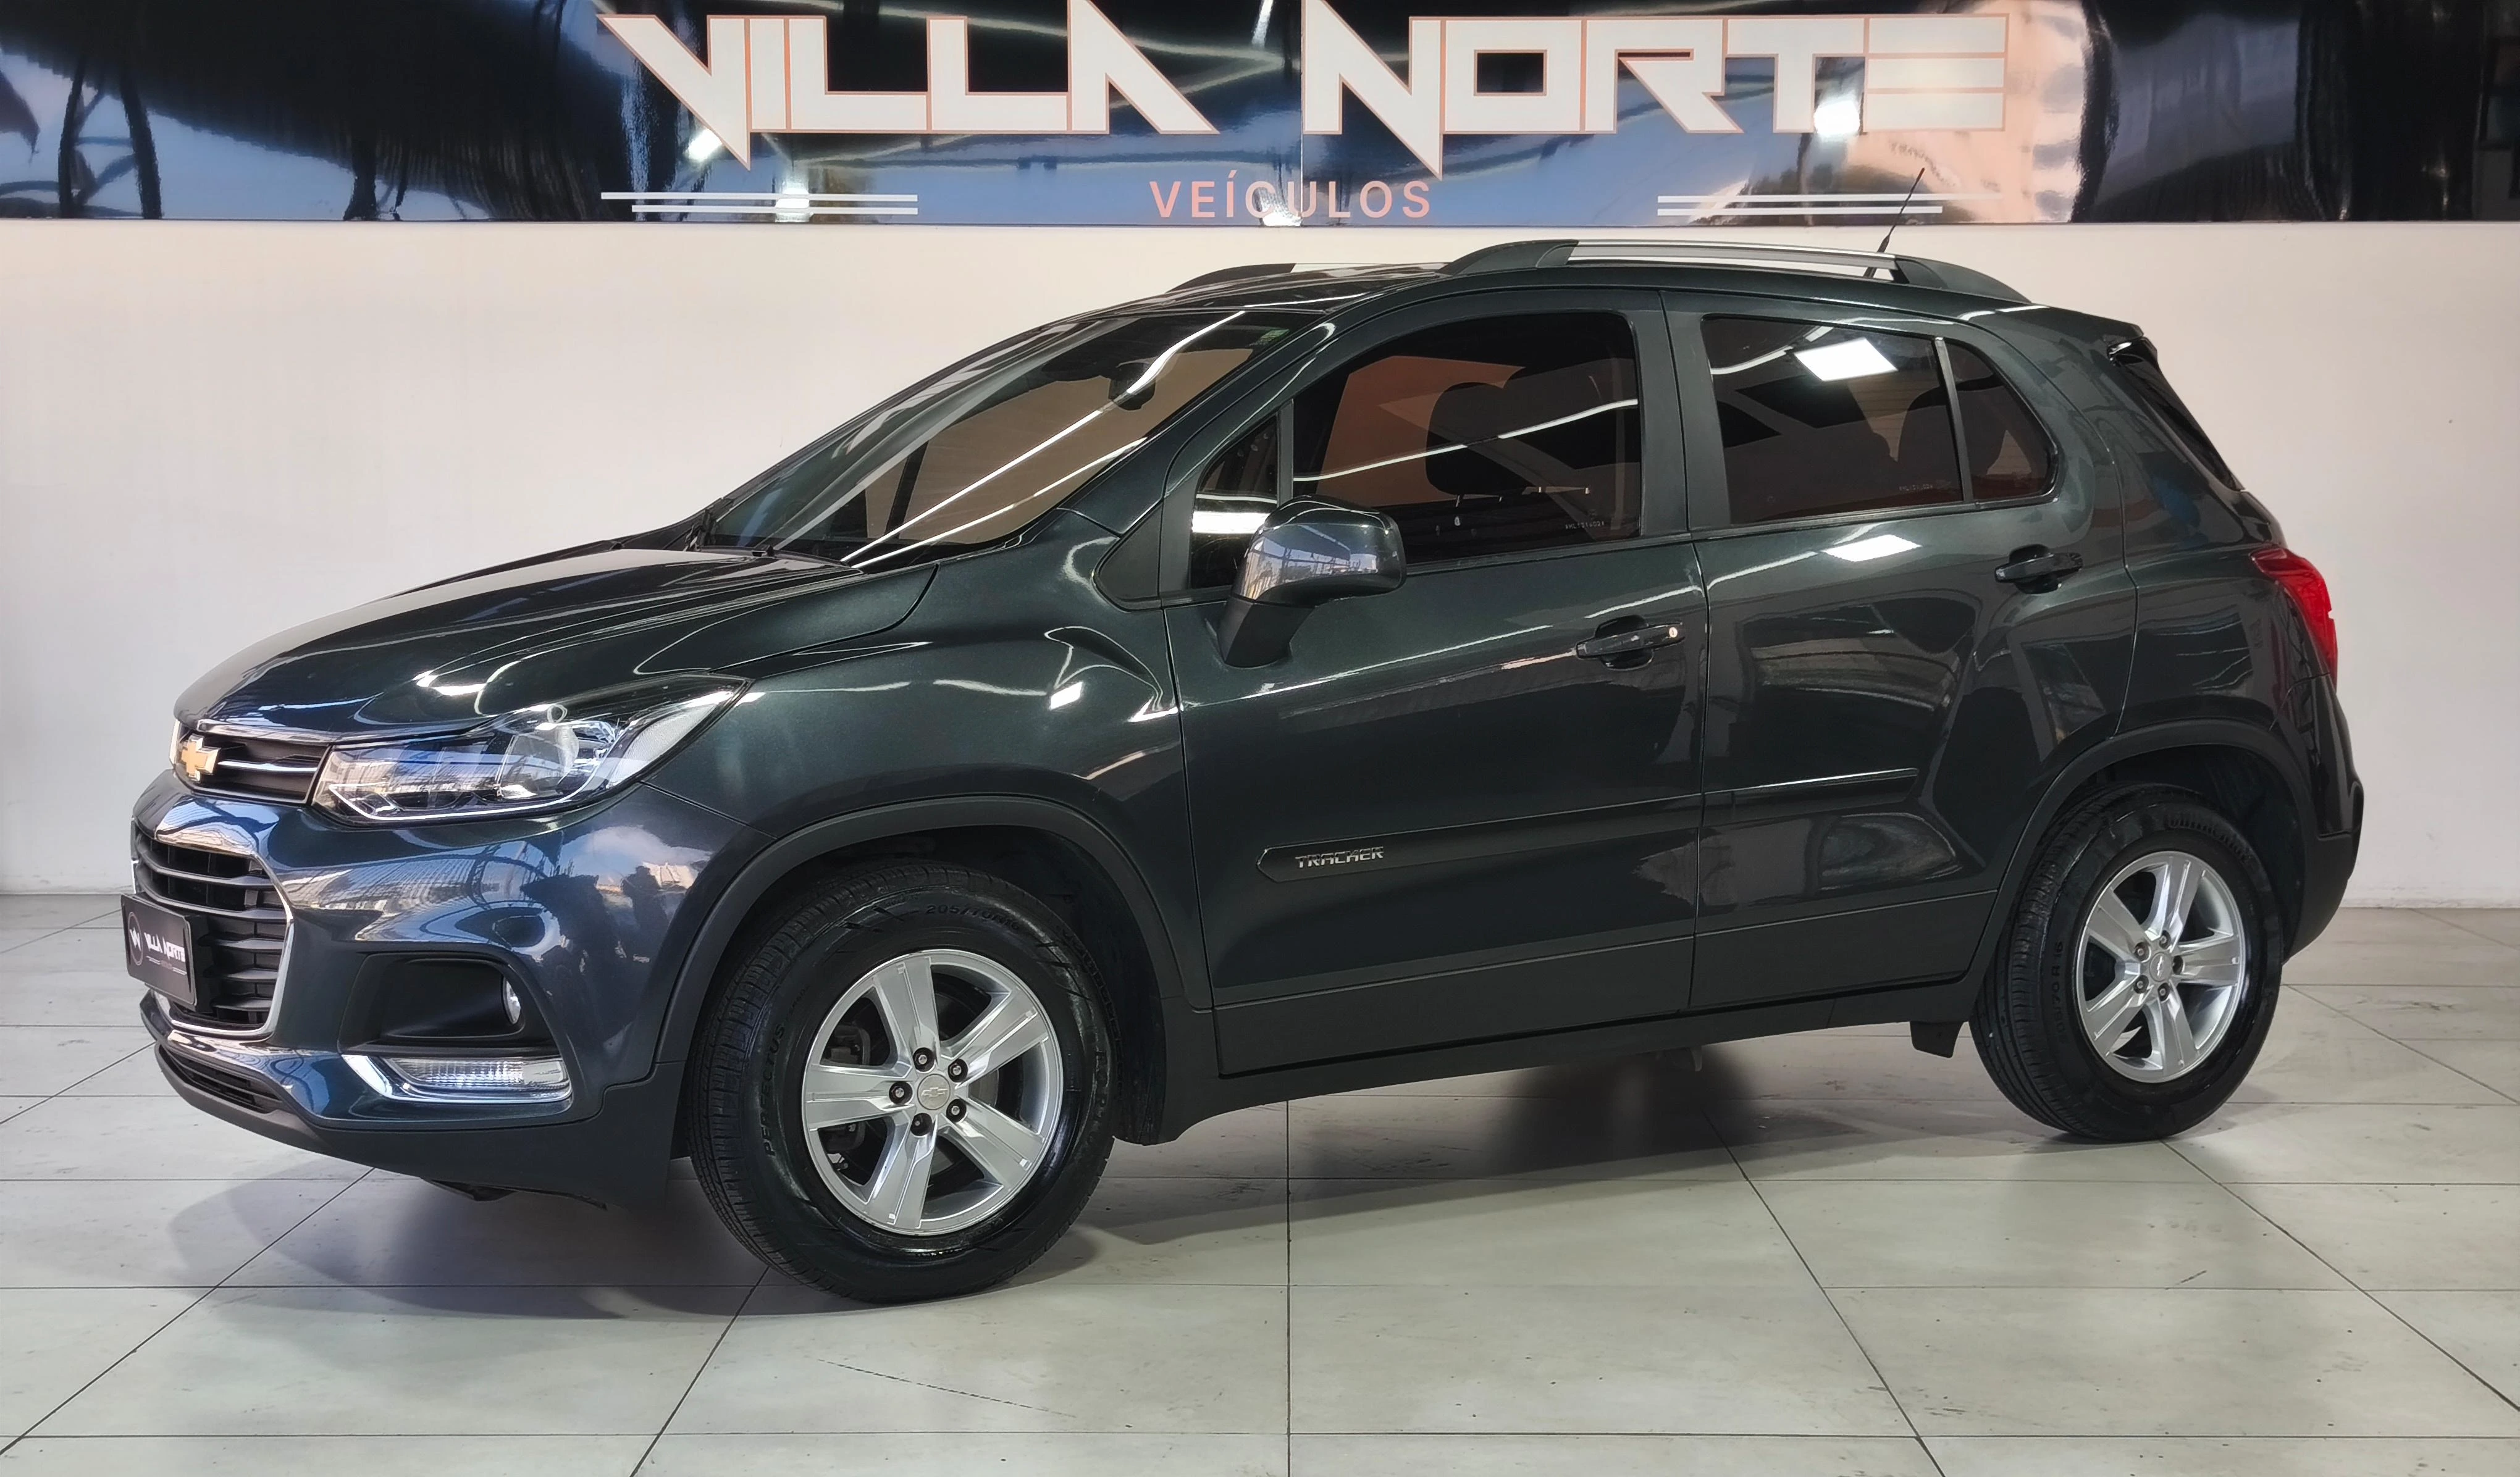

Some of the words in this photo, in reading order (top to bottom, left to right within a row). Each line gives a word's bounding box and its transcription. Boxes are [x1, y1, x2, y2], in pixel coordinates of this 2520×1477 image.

[595, 0, 1220, 170] VILLA
[1302, 0, 2010, 181] NORTE
[1149, 169, 1431, 219] VEÍCULOS
[1295, 846, 1384, 868] TRACKER
[143, 932, 163, 953] VILLA
[162, 936, 186, 963] NORTE
[759, 1023, 786, 1157] PERFECTUS
